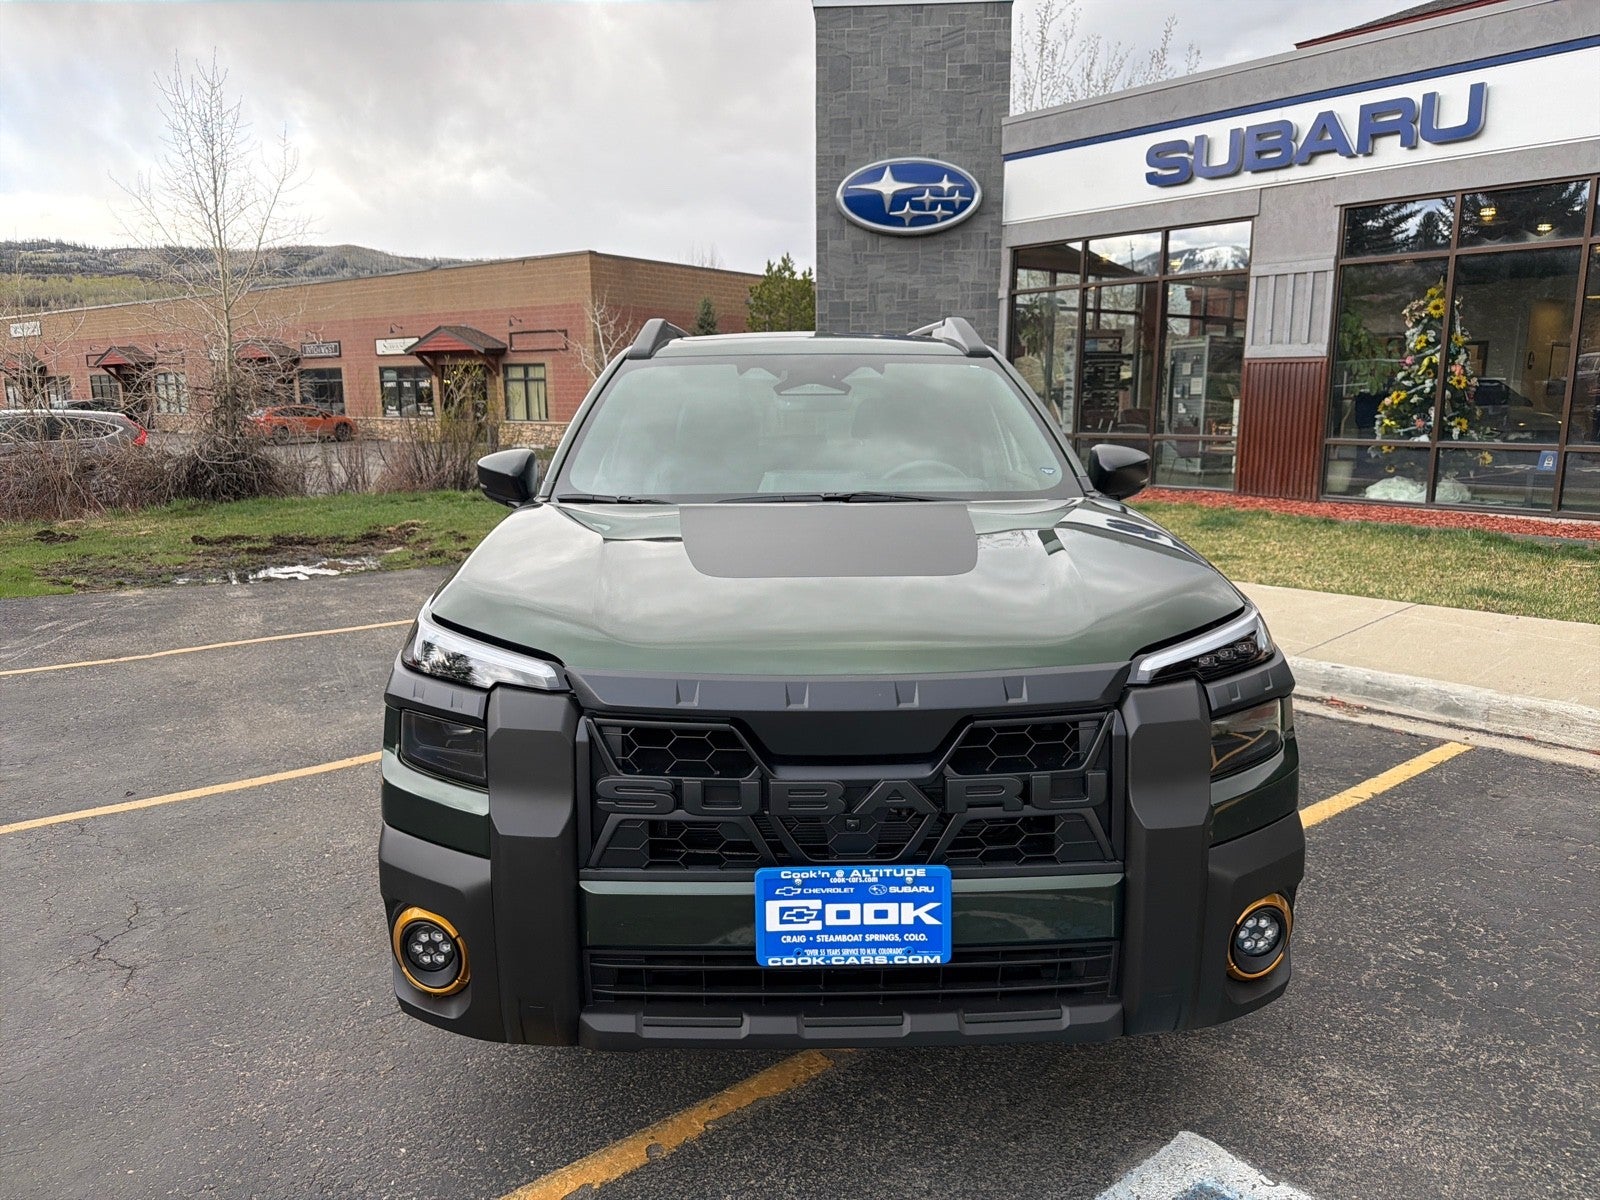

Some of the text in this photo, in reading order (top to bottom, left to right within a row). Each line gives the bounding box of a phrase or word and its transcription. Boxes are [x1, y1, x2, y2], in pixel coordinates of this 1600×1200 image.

[1145, 82, 1487, 187] SUBARU
[596, 772, 1107, 815] SUBARU
[781, 871, 830, 879] Cook'n
[850, 868, 927, 878] ALTITUDE
[766, 899, 943, 932] COOK
[781, 933, 928, 943] CRAIG STEAMBOAT SPRINGS, COLO.
[767, 955, 942, 966] COOK-CARS.COM
